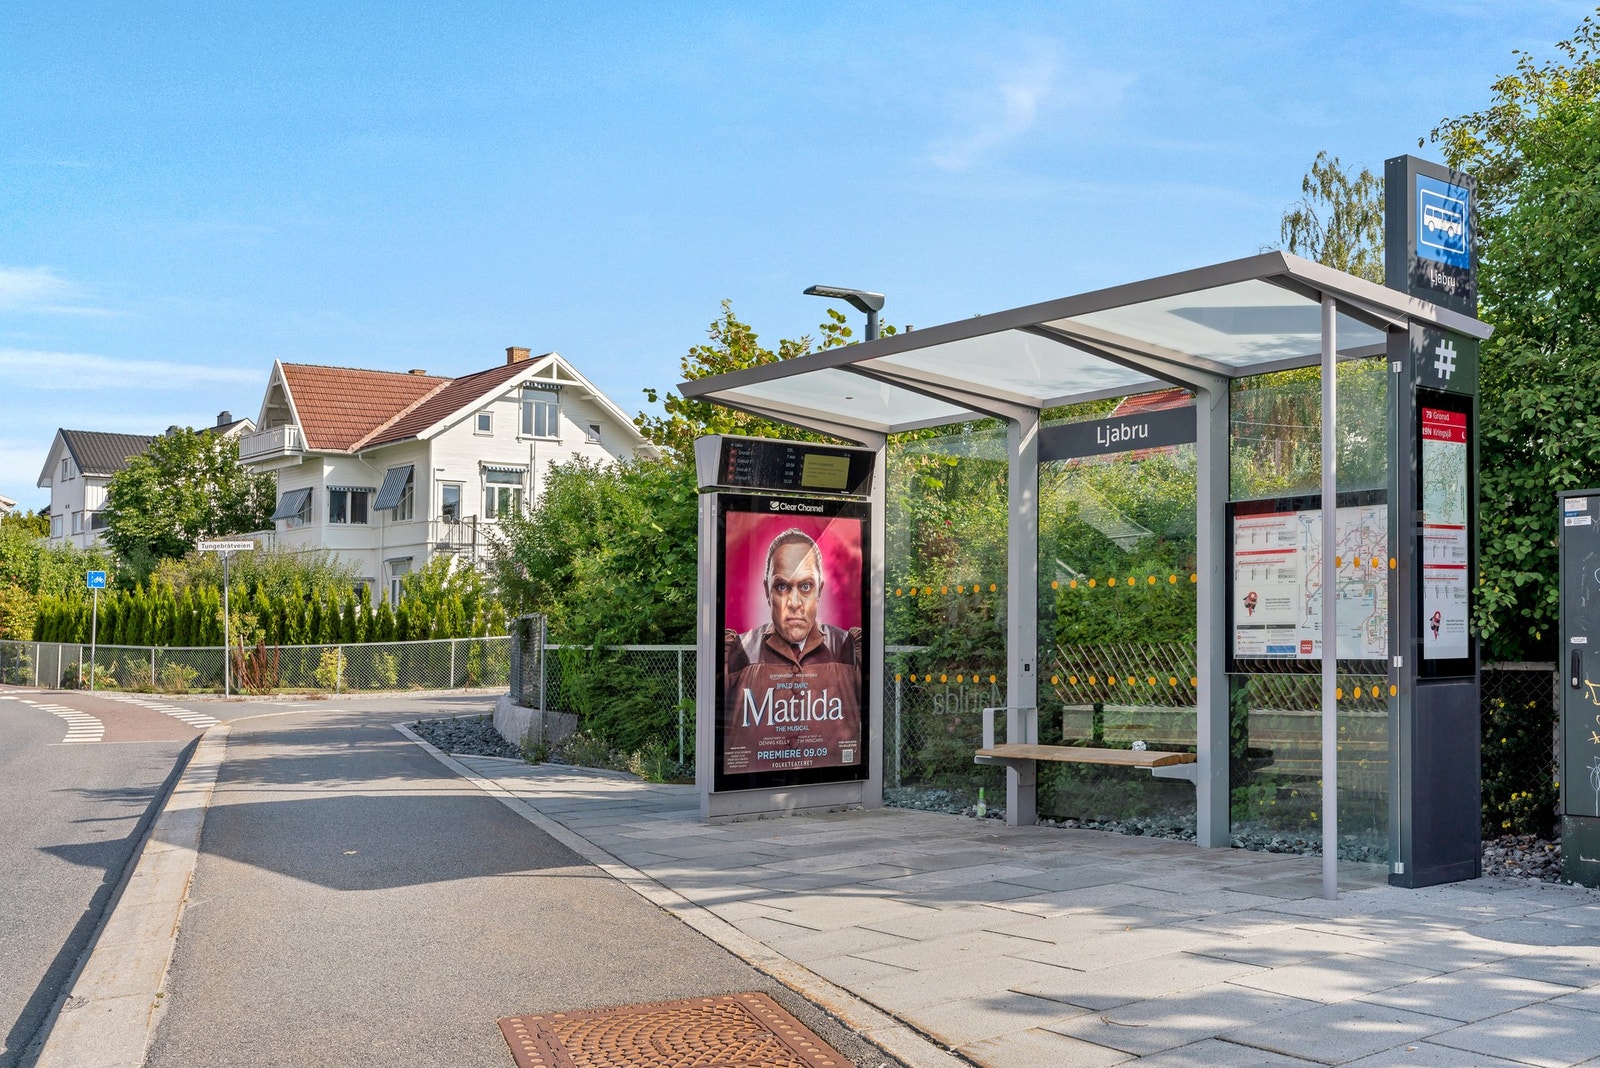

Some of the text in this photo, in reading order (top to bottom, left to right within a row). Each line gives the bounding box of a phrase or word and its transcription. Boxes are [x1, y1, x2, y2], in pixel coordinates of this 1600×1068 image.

[1430, 269, 1456, 287] Ljabru
[1425, 410, 1433, 419] 79
[1096, 422, 1149, 447] Ljabru
[779, 502, 824, 513] Clear Channel
[741, 687, 845, 727] Matilda
[757, 748, 801, 760] PREMIERE
[803, 747, 828, 757] 09.09
[771, 760, 813, 769] FOLKETEATERET
